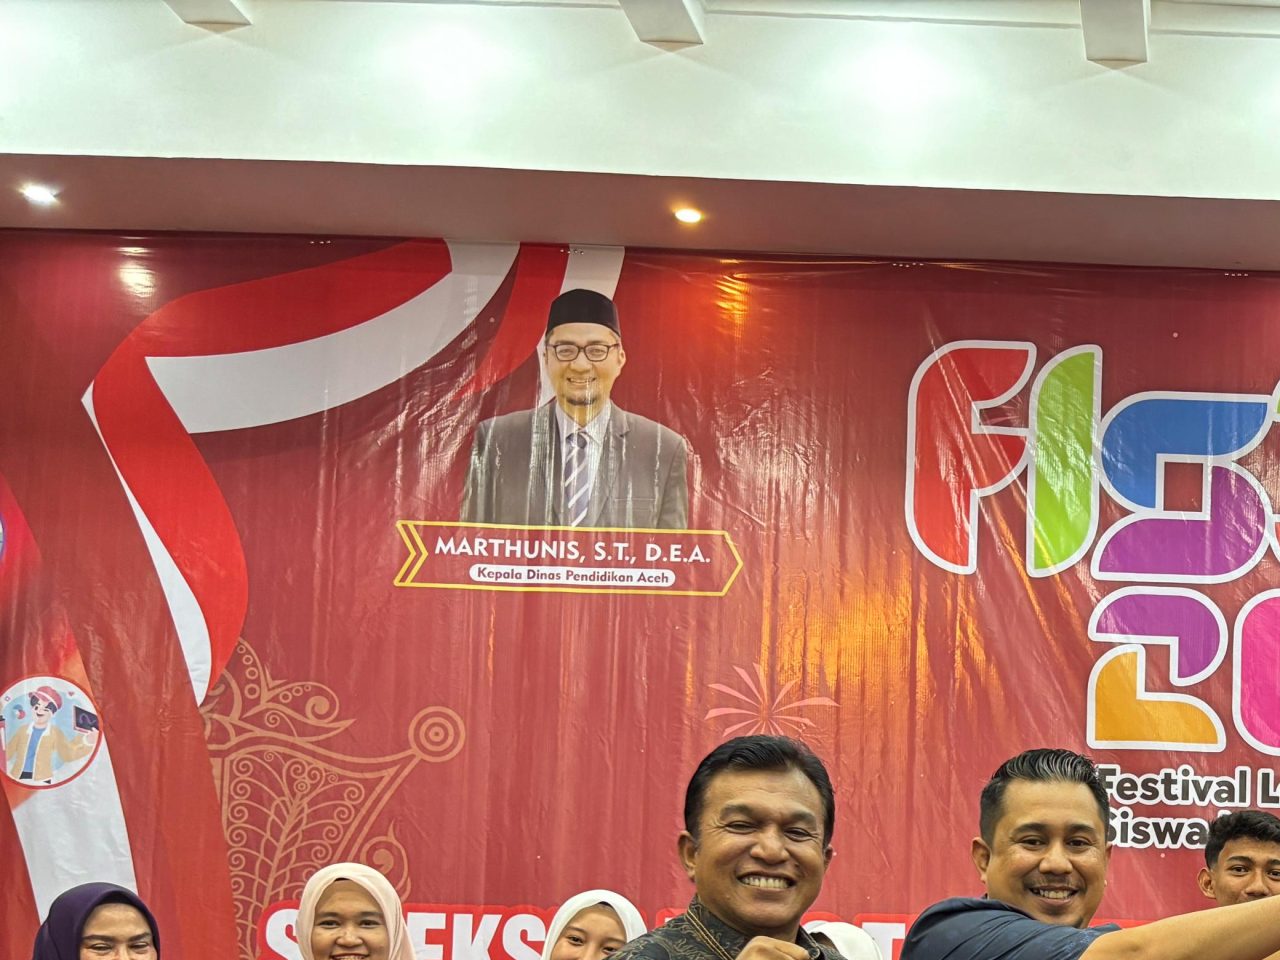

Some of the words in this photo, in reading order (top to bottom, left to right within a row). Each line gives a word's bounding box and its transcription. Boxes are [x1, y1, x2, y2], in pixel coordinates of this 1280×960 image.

[435, 536, 586, 563] MARTHUNIS,
[594, 542, 636, 564] S.T.,
[645, 544, 711, 563] D.E.A.
[478, 567, 522, 581] Kepala
[527, 569, 561, 580] Dinas
[566, 570, 633, 582] Pendidikan
[637, 572, 668, 583] Aceh
[1100, 768, 1247, 803] Festival
